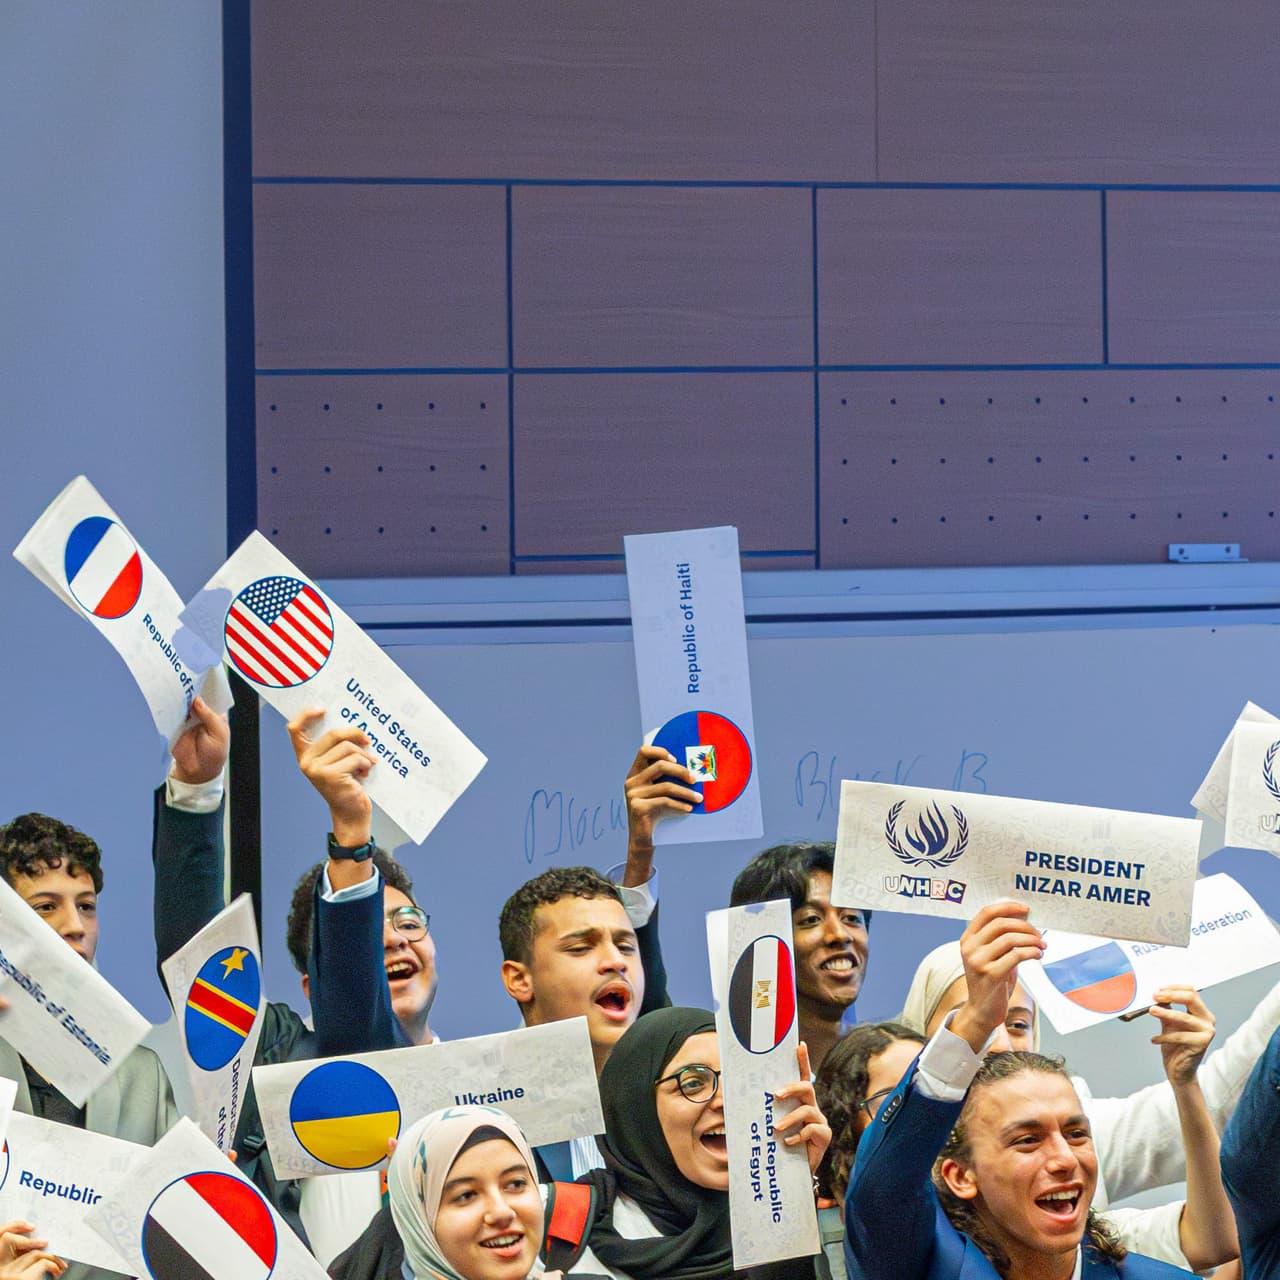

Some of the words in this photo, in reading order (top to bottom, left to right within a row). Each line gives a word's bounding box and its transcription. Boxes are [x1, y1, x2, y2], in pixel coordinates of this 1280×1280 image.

[676, 563, 692, 600] Haiti
[680, 604, 694, 620] of
[143, 614, 181, 672] Republic
[180, 672, 192, 687] of
[682, 624, 701, 693] Republic
[346, 678, 391, 725] United
[389, 722, 431, 767] States
[341, 708, 359, 723] of
[358, 722, 409, 778] America
[1025, 851, 1145, 880] PRESIDENT
[885, 875, 966, 904] UNHRC
[1015, 874, 1081, 898] NIZAR
[1086, 884, 1151, 907] AMER
[1192, 909, 1252, 936] ederation
[45, 1002, 66, 1017] of
[61, 1014, 112, 1066] Estonia
[455, 1087, 525, 1106] Ukraine
[764, 1092, 775, 1136] Arab
[751, 1122, 761, 1142] of
[750, 1147, 763, 1202] Egypt
[766, 1141, 782, 1224] Republic
